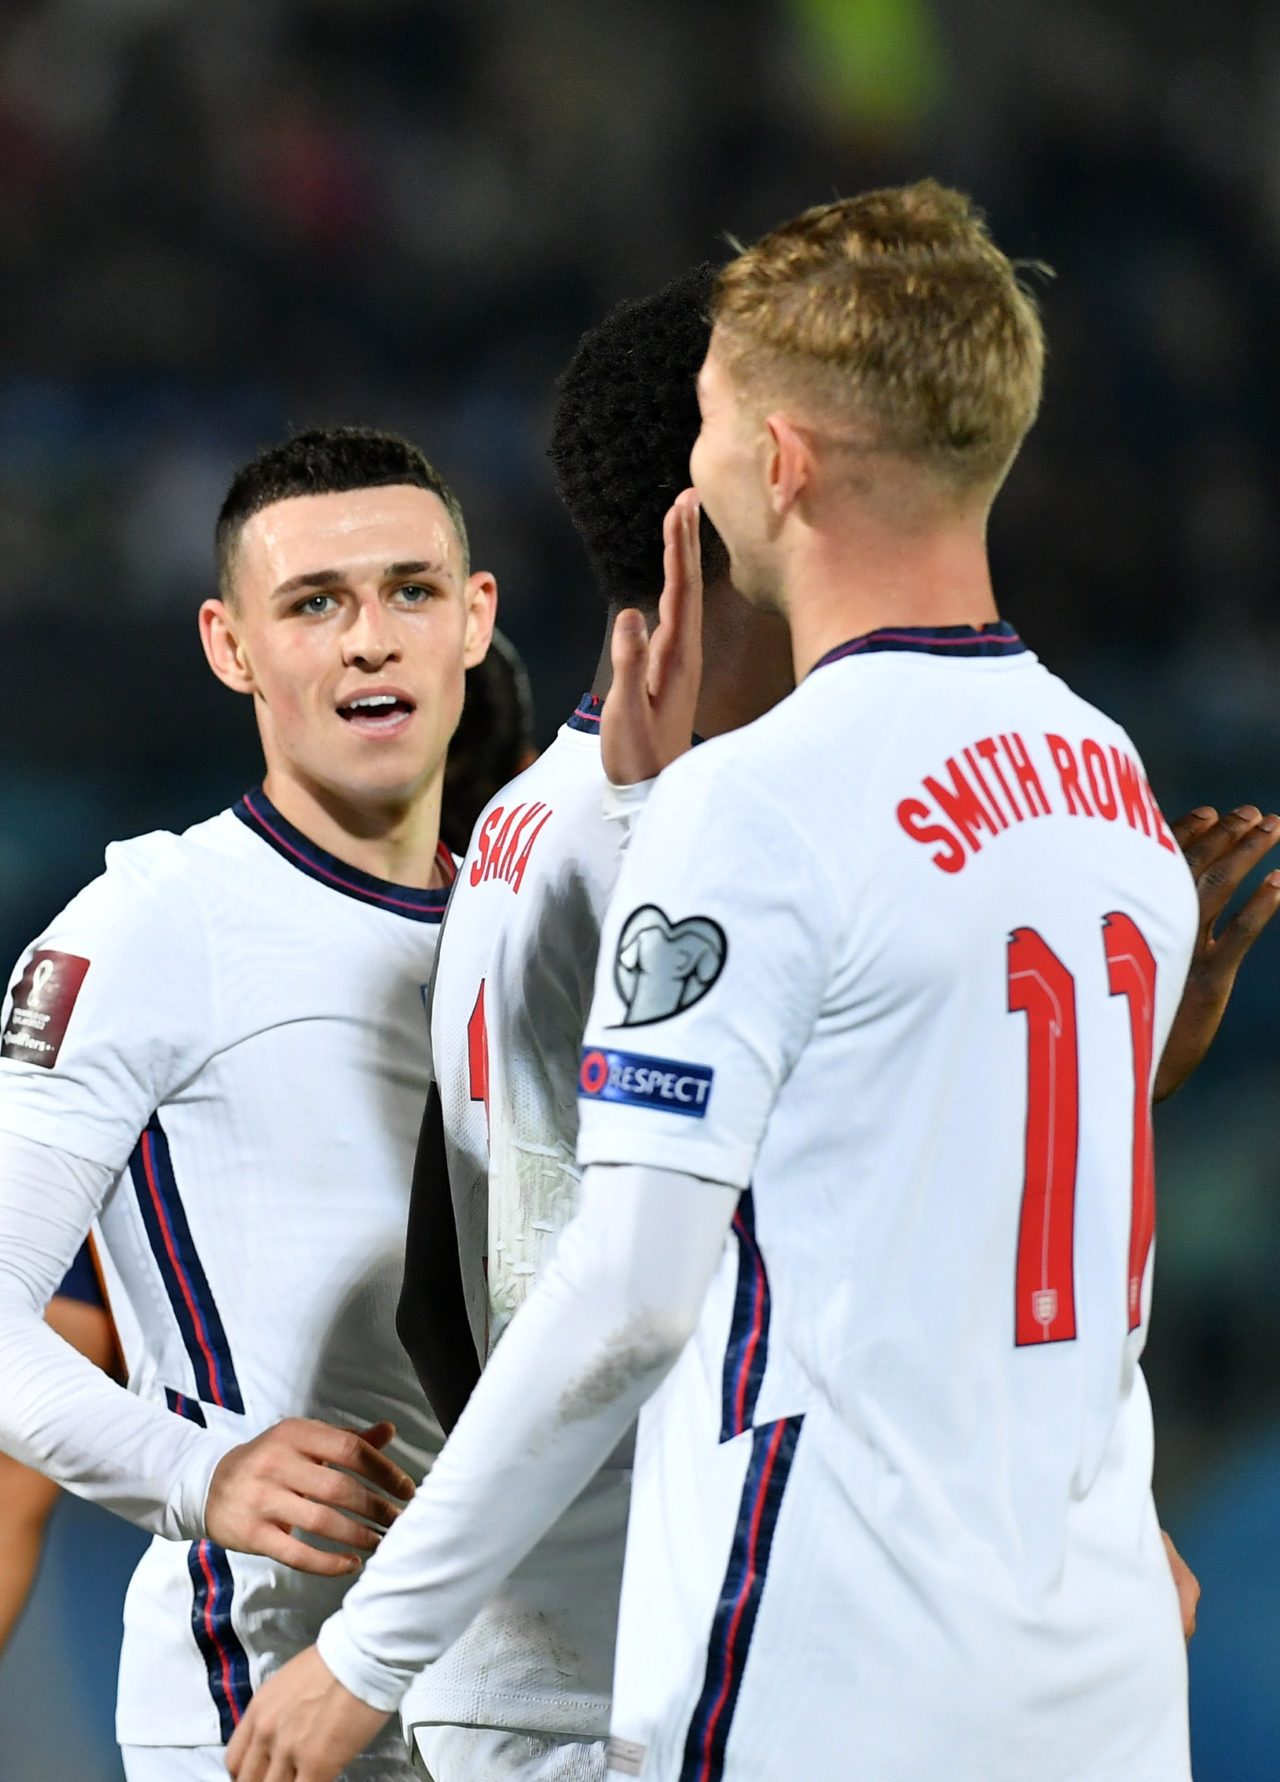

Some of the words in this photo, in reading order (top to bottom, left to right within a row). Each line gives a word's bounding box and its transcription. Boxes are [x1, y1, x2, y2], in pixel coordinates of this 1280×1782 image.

[470, 801, 553, 895] SAKA
[896, 732, 1053, 874] SMITH
[608, 1066, 711, 1104] RESPECT
[1007, 911, 1157, 1347] 11
